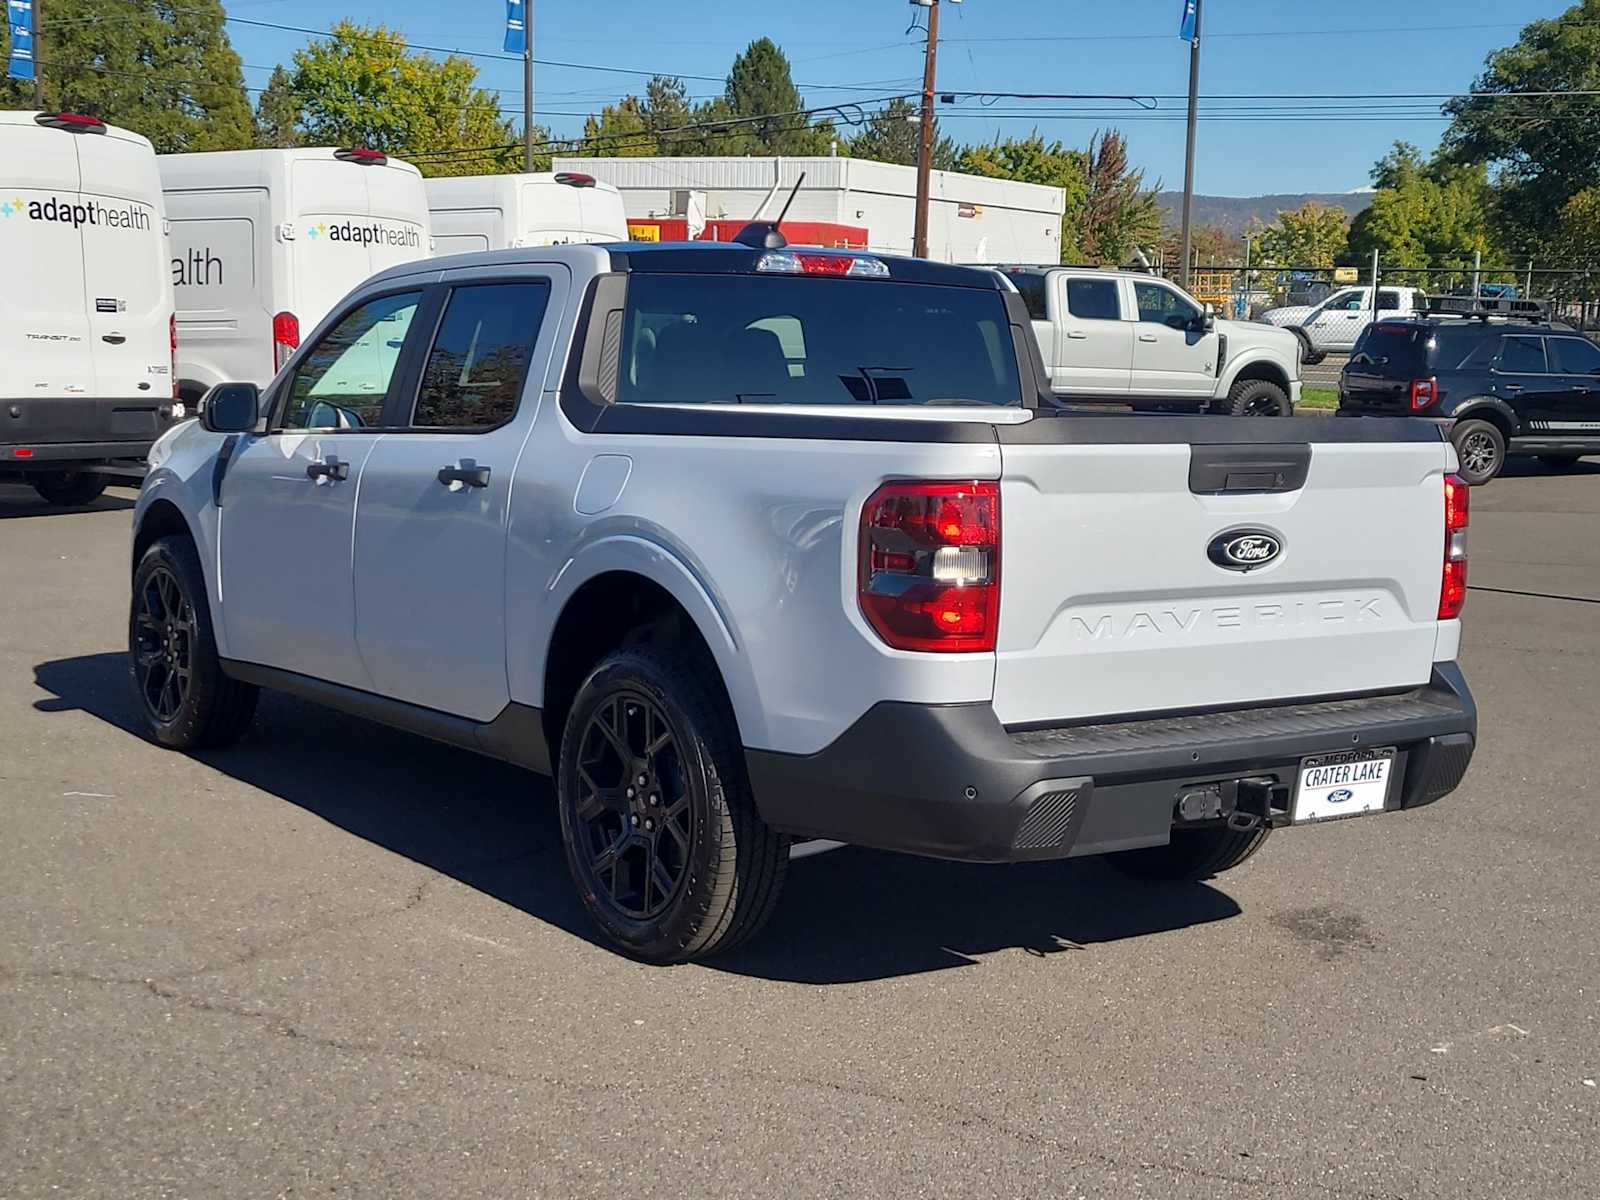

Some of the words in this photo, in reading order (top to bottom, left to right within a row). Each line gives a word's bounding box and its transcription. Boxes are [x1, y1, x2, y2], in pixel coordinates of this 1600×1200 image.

[28, 196, 151, 231] adapthealth
[329, 220, 421, 249] adapthealth
[1236, 539, 1271, 559] Ford
[1071, 597, 1382, 641] MAVERICK
[1305, 765, 1351, 787] CRATER
[1353, 762, 1384, 781] LAKE
